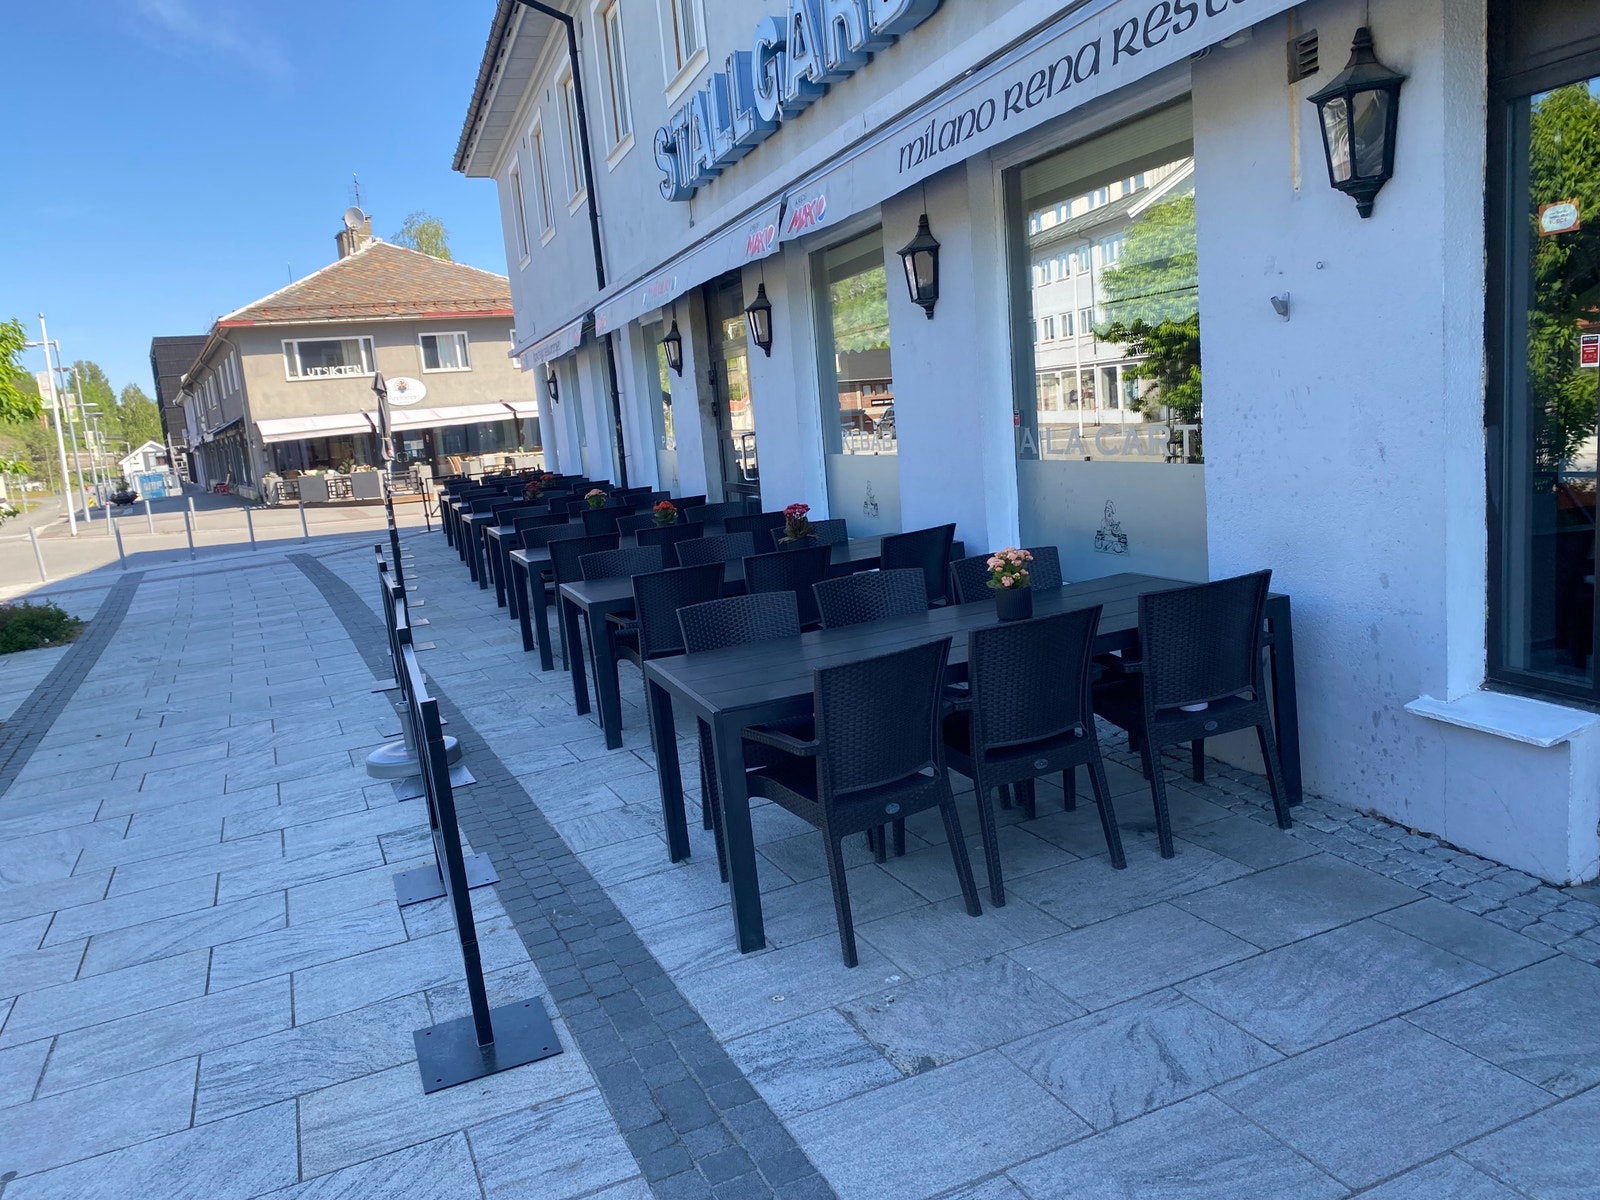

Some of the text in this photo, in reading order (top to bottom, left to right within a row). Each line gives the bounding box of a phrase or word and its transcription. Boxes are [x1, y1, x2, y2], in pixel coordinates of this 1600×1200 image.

[899, 99, 996, 174] milano
[1112, 0, 1246, 66] Res
[787, 198, 818, 234] MAX
[745, 229, 767, 257] MAX
[306, 364, 363, 376] UTSIKTEN
[841, 430, 894, 451] KEBAB
[1020, 424, 1204, 458] A LA CART
